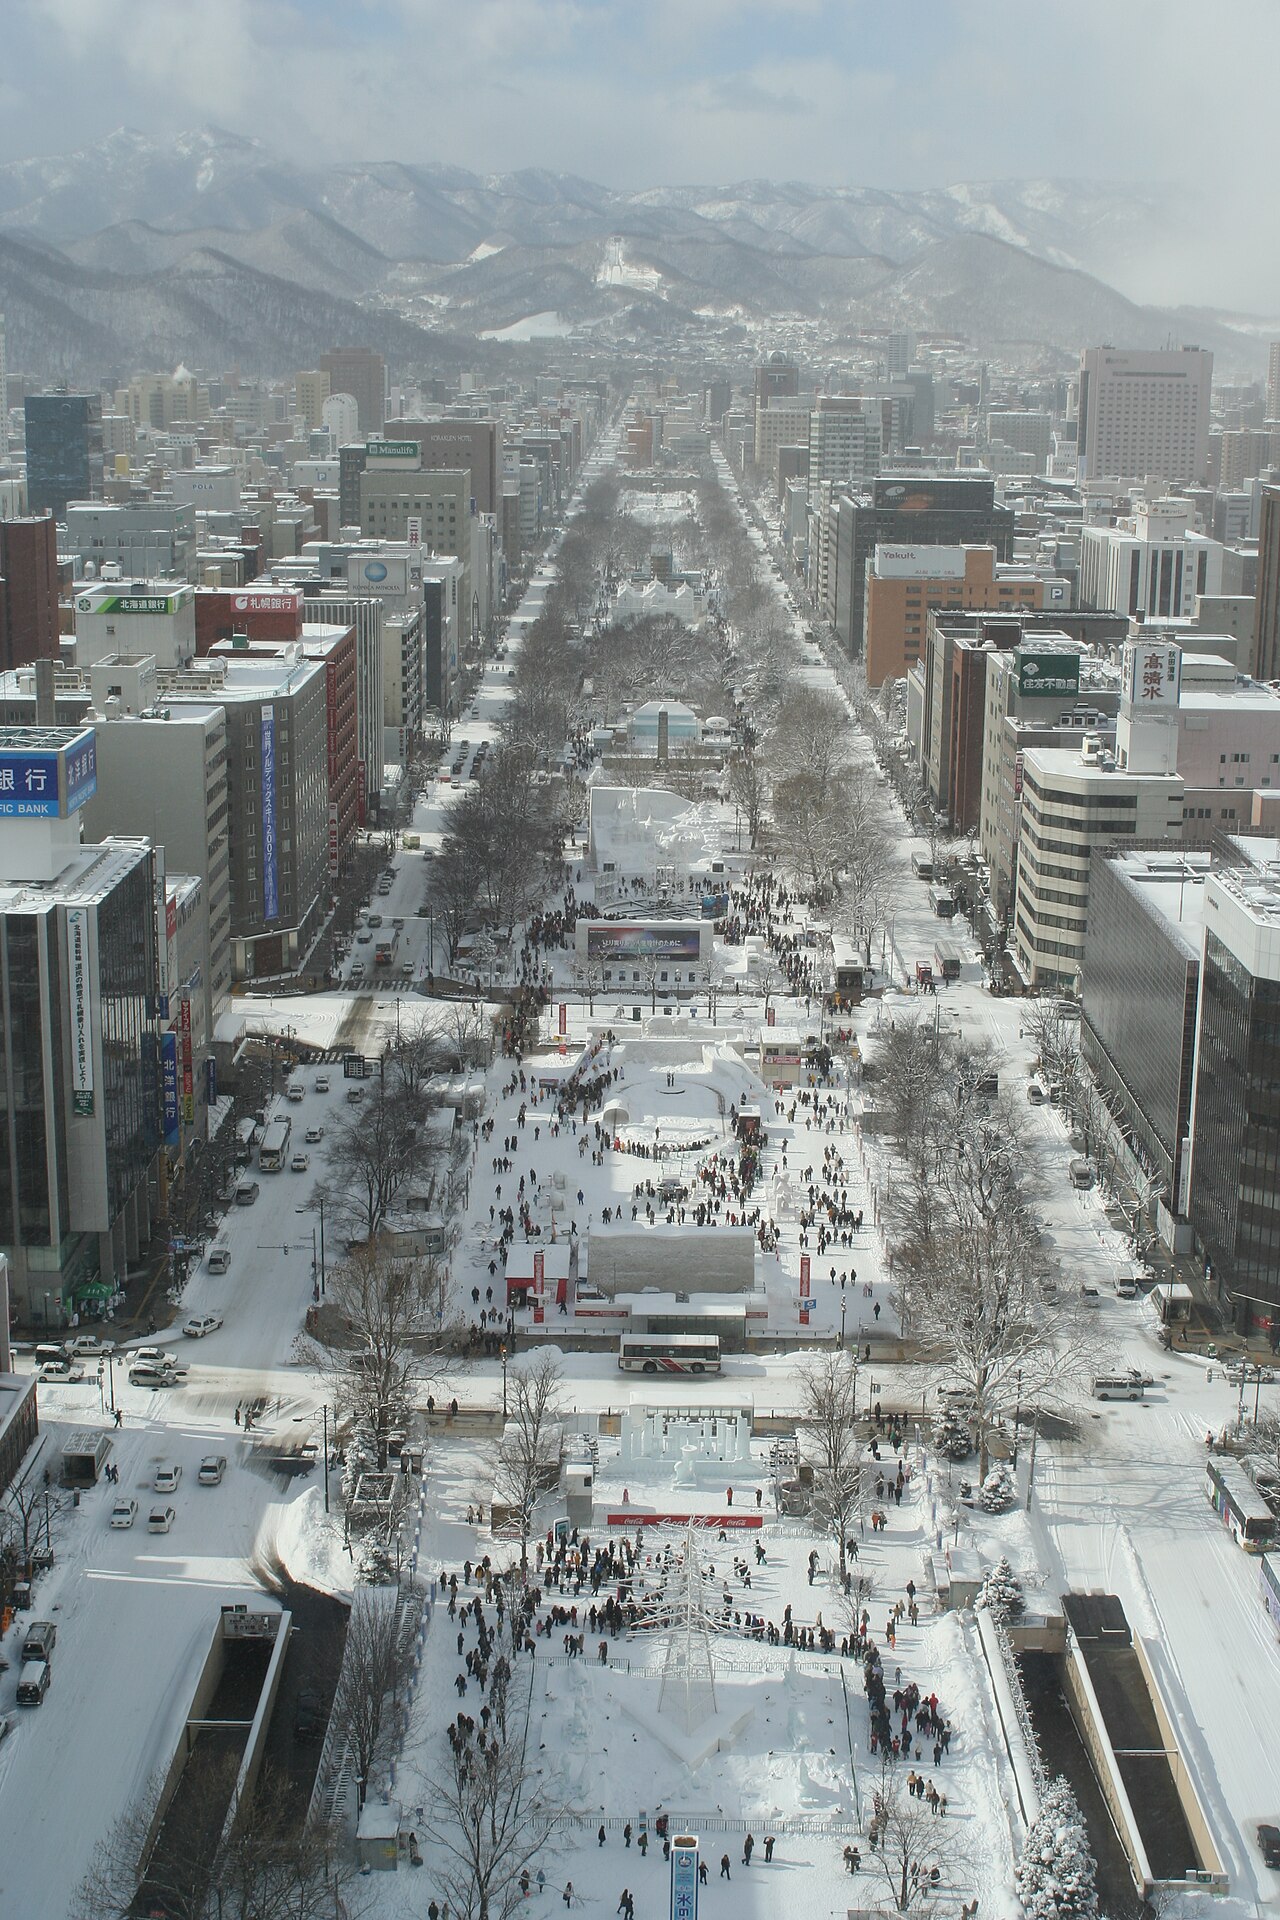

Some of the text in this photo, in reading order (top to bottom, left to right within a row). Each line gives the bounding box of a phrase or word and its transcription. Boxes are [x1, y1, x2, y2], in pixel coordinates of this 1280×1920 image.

[379, 446, 414, 455] Manulife
[884, 551, 916, 560] Yakult
[1052, 588, 1063, 599] P
[120, 599, 167, 609] 北海道銀行
[251, 597, 292, 609] 札幌銀行
[1023, 678, 1077, 690] 住友不動産
[0, 768, 48, 791] 銀行
[18, 804, 49, 813] BANK
[164, 1059, 176, 1119] 北洋銀行
[676, 1893, 693, 1920] 氷の
